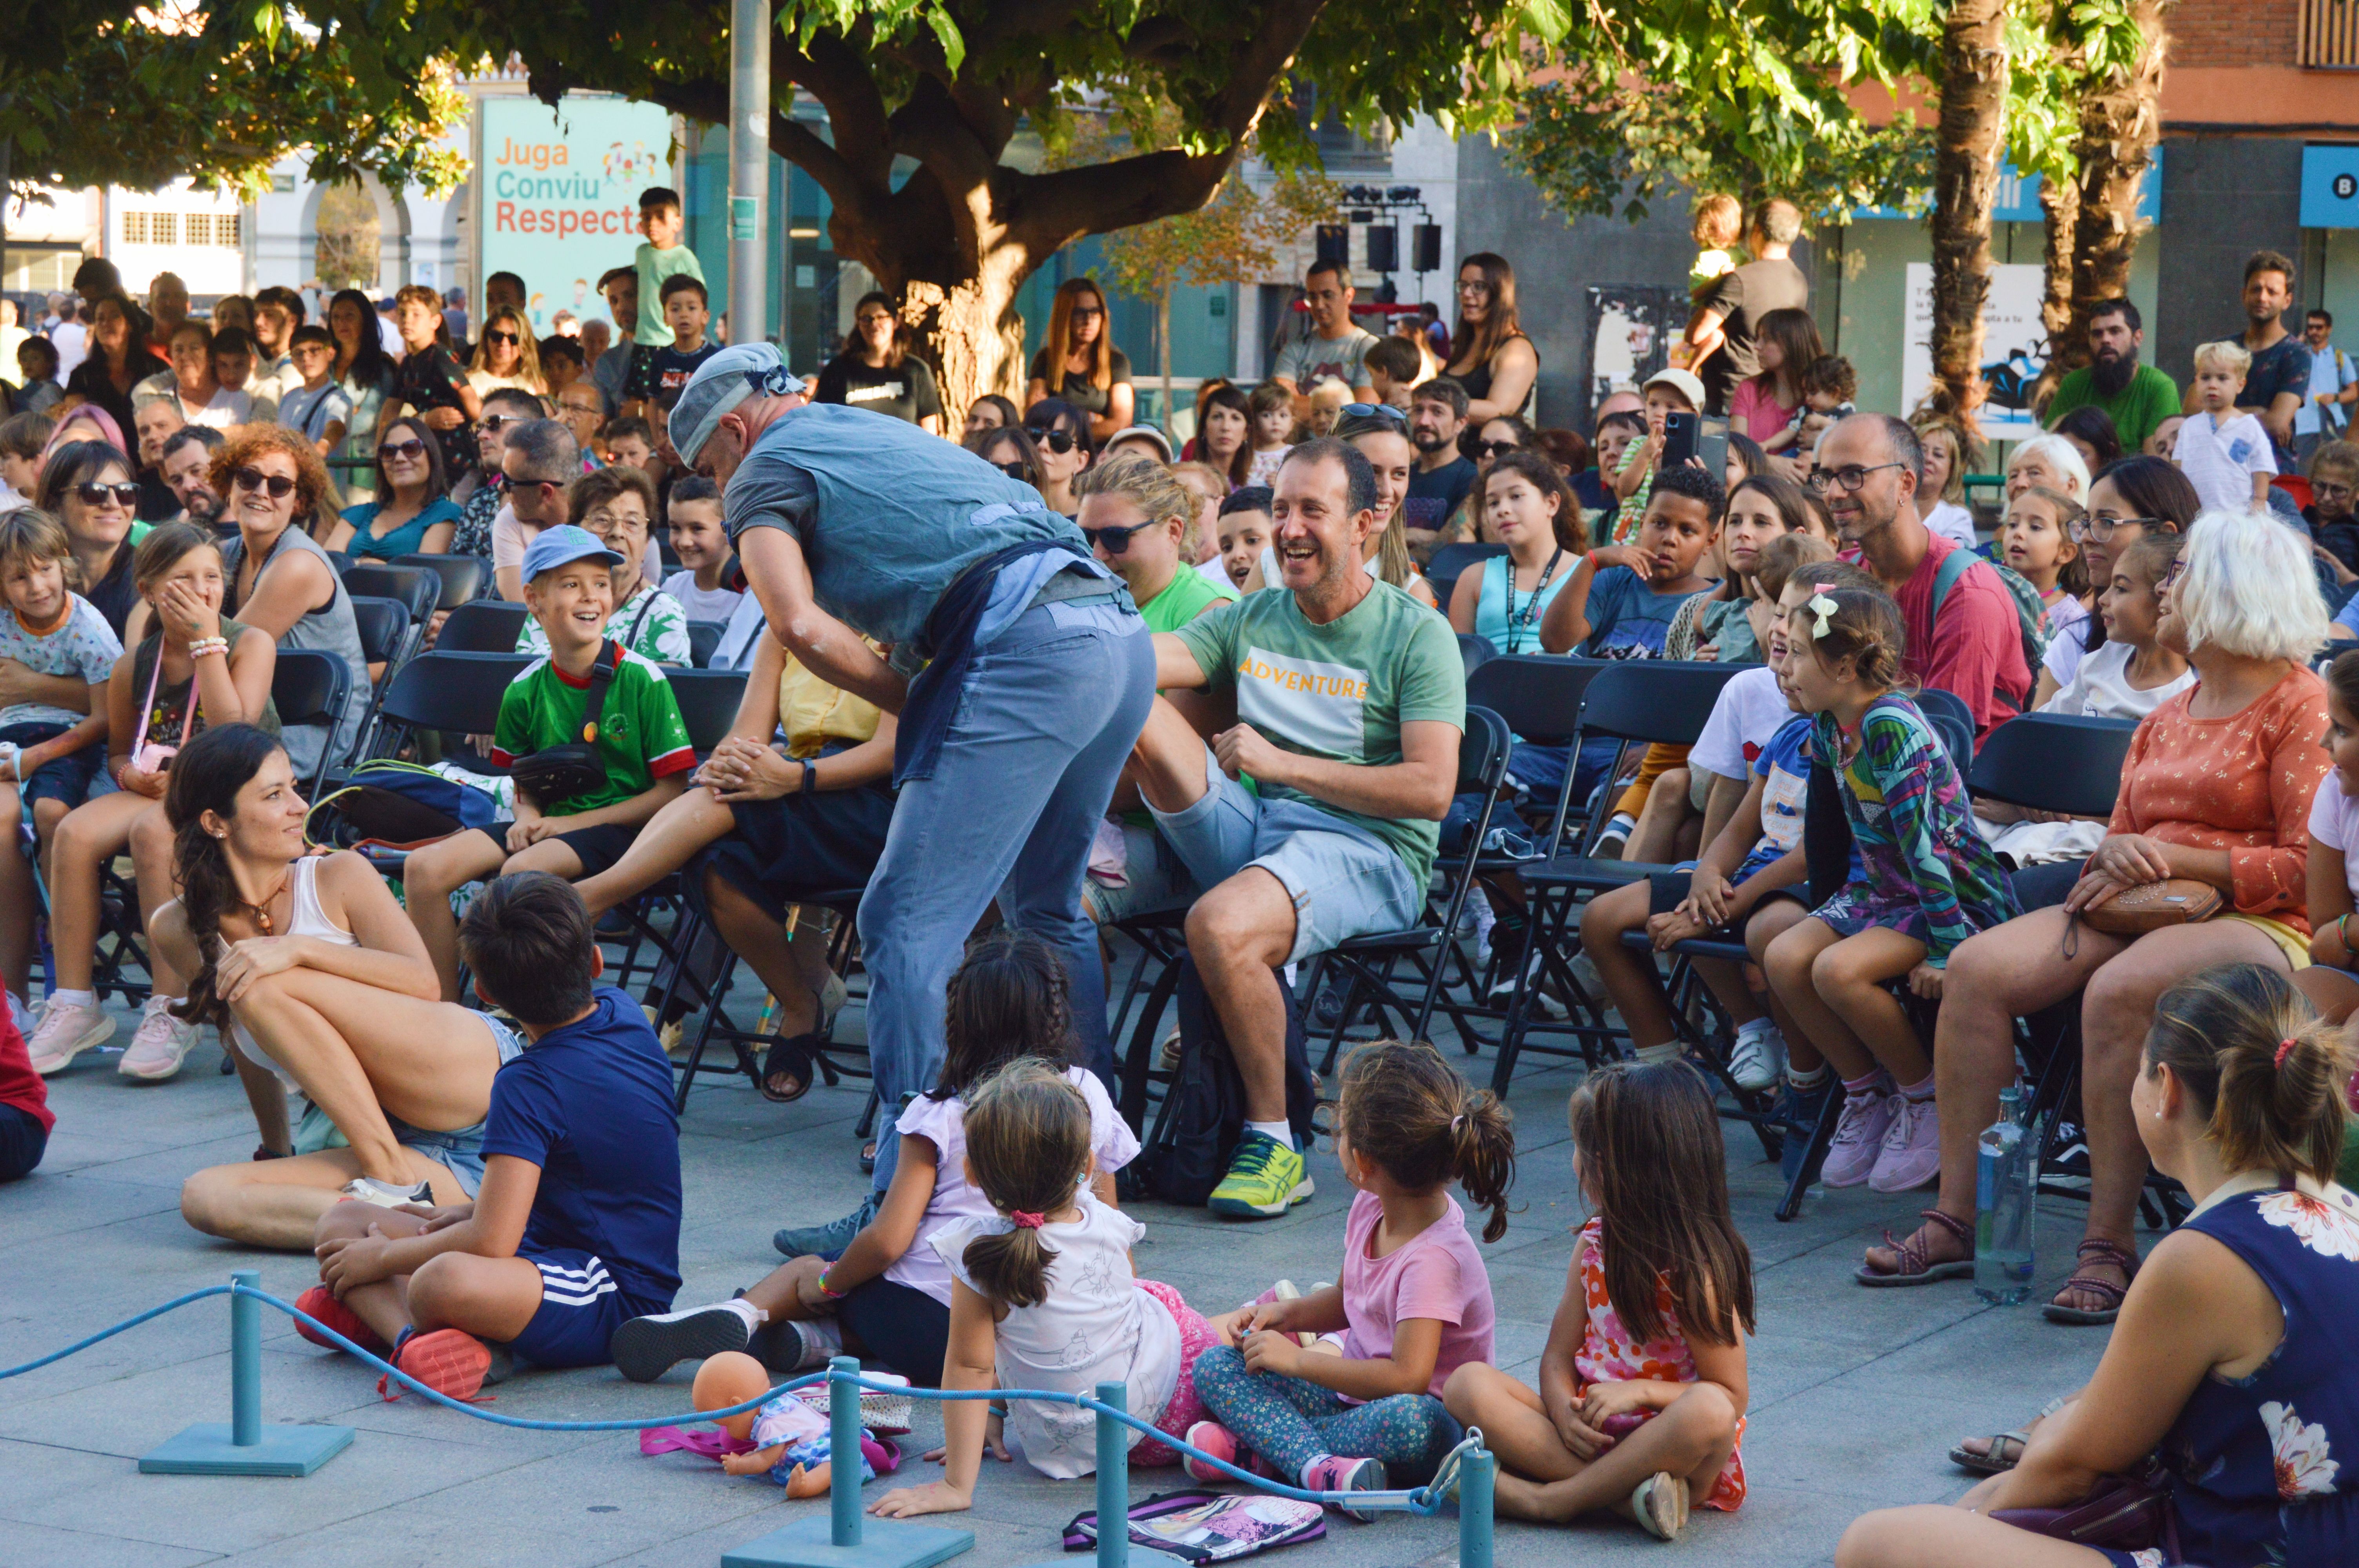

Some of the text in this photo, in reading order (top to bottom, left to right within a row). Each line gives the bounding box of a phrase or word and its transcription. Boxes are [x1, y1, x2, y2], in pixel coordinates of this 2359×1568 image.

[496, 137, 568, 171] Juga
[496, 170, 599, 200] Conviu
[2338, 178, 2352, 195] B
[1238, 657, 1370, 700] ADVENTURE
